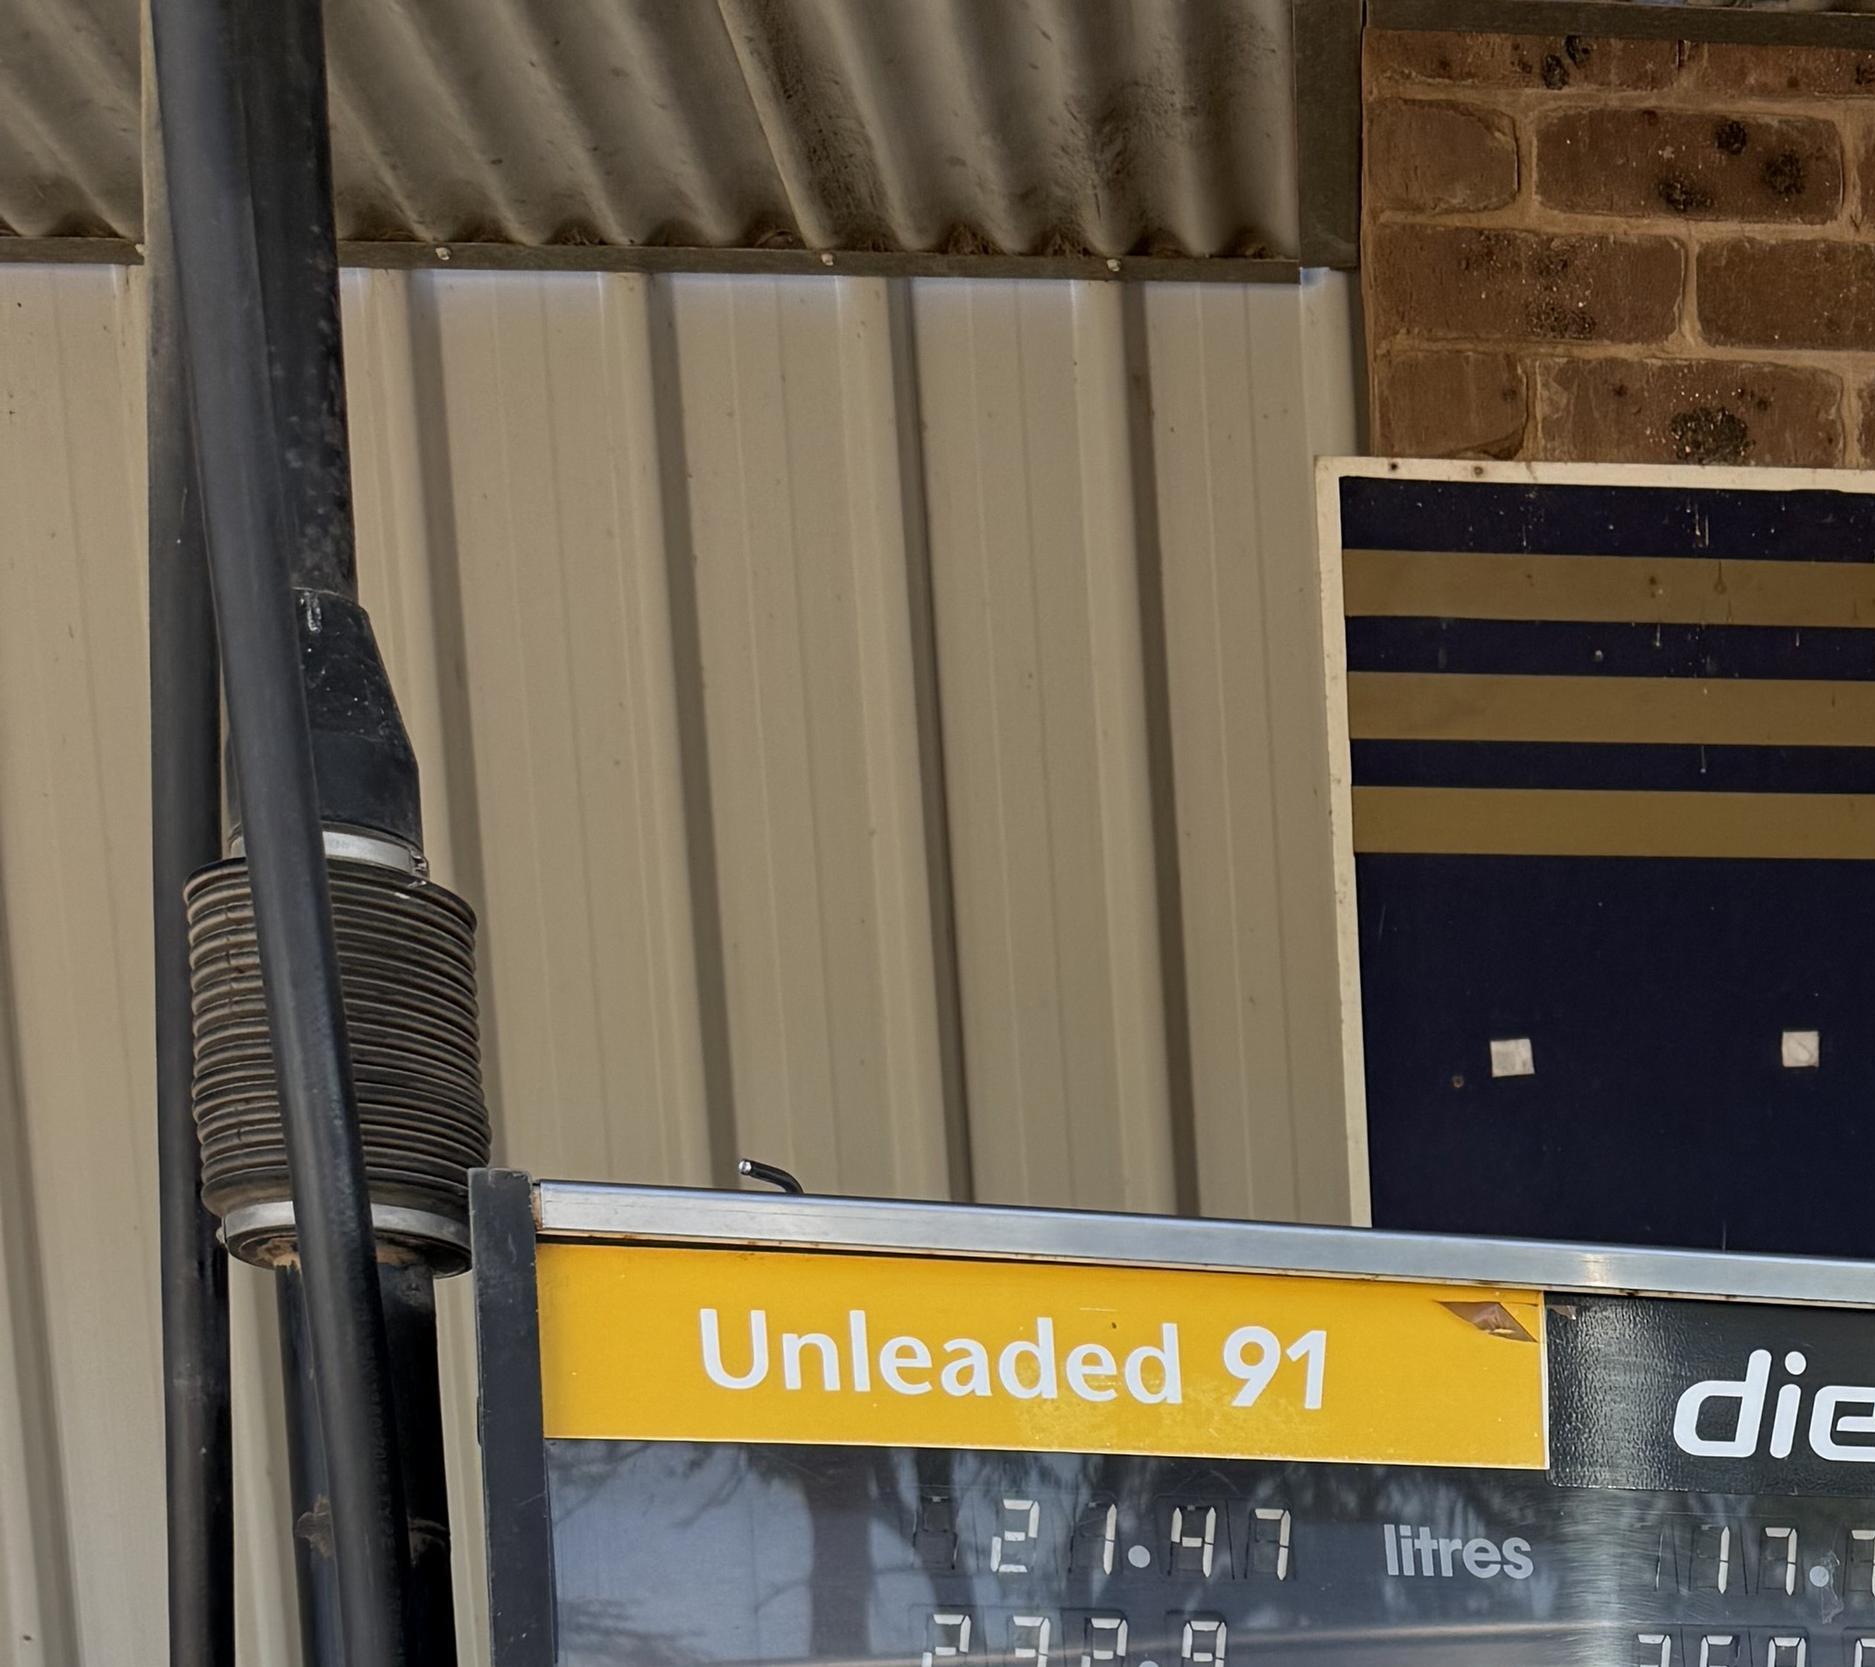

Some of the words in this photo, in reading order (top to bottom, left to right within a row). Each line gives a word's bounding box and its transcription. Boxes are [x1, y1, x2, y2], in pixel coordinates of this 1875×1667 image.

[700, 1309, 1182, 1404] Unleaded
[1224, 1326, 1326, 1409] 91
[990, 1498, 1290, 1580] 21.47
[1384, 1524, 1533, 1579] litres
